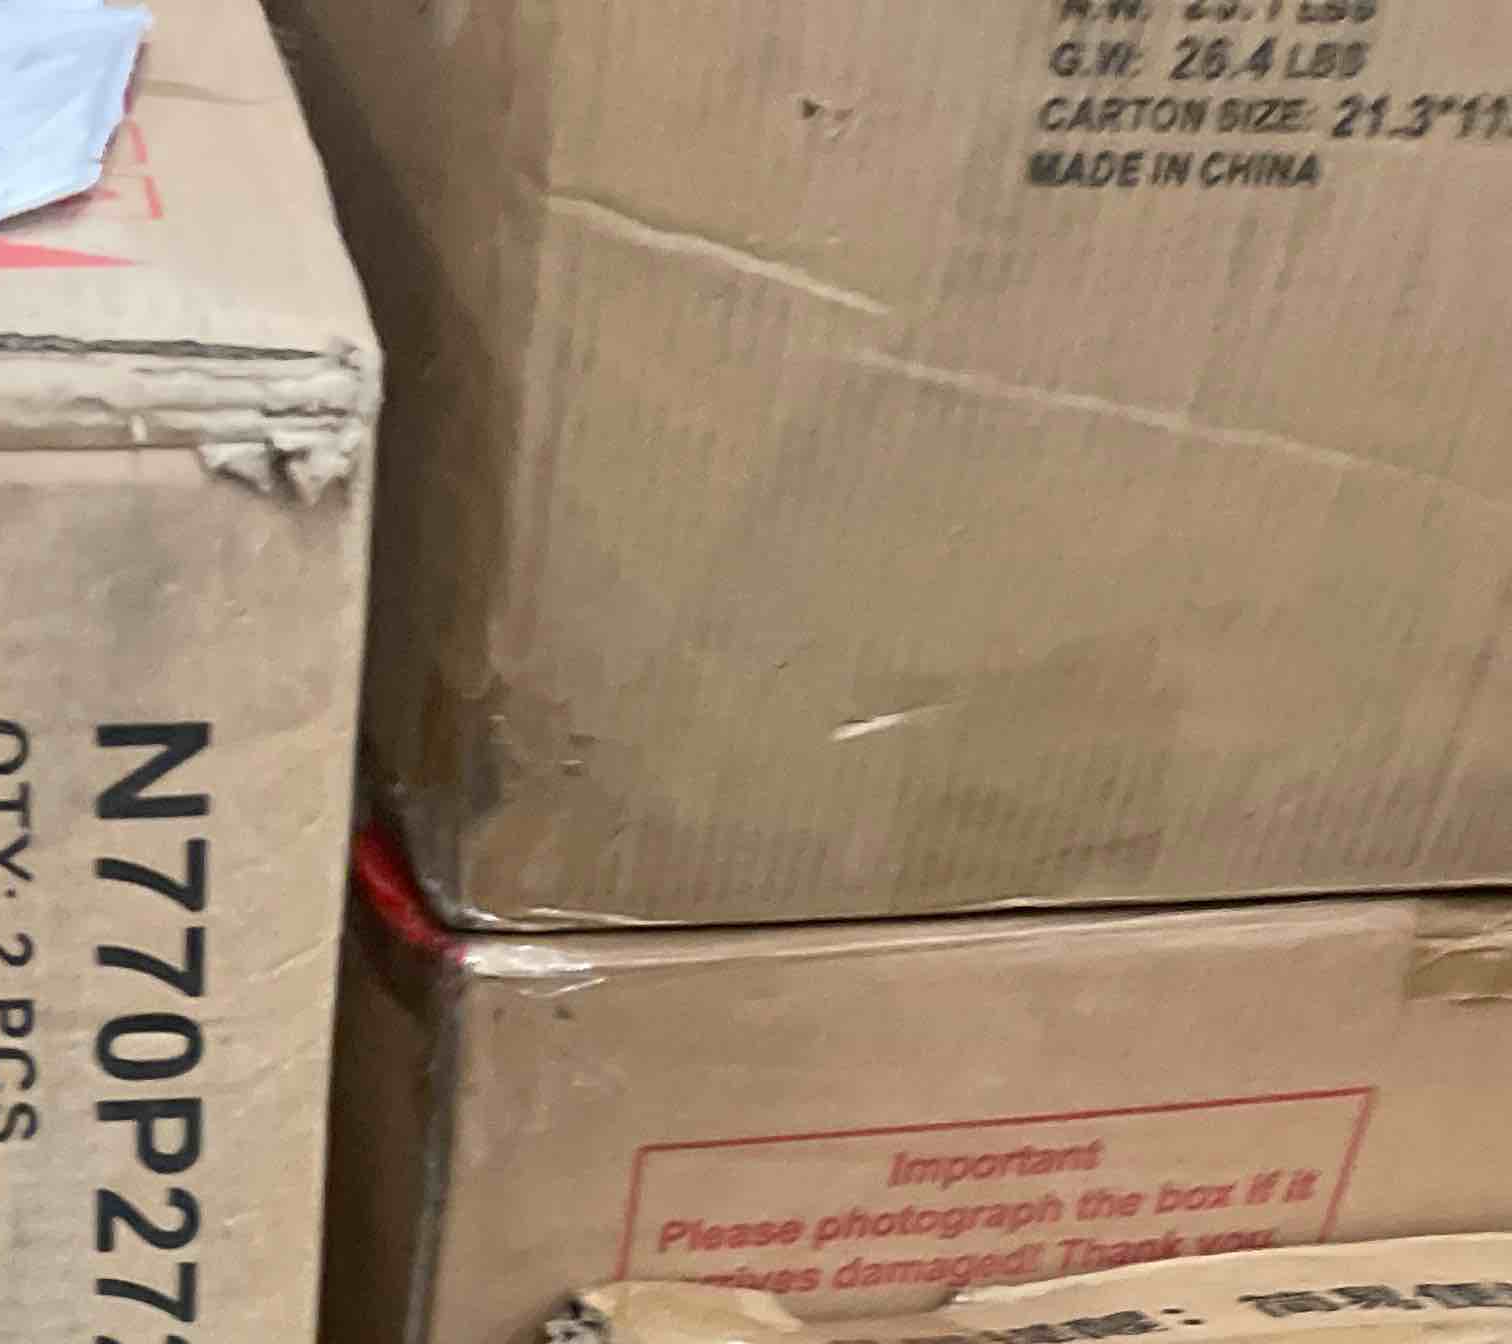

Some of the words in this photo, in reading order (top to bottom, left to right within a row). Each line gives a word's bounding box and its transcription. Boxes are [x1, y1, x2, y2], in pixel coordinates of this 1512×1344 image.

[1168, 36, 1278, 80] 26.4
[1284, 42, 1368, 80] LBS
[1038, 97, 1209, 133] CARTON
[1029, 152, 1144, 187] MADE
[1151, 152, 1191, 186] IN
[1199, 152, 1322, 188] CHINA
[889, 1139, 1104, 1189] Important
[658, 1218, 800, 1252] Please
[812, 1194, 1066, 1247] photograph
[1076, 1189, 1144, 1221] the
[1154, 1182, 1235, 1212] box
[1288, 1169, 1322, 1201] it
[832, 1245, 1044, 1290] damaged!
[1057, 1232, 1183, 1275] Thank
